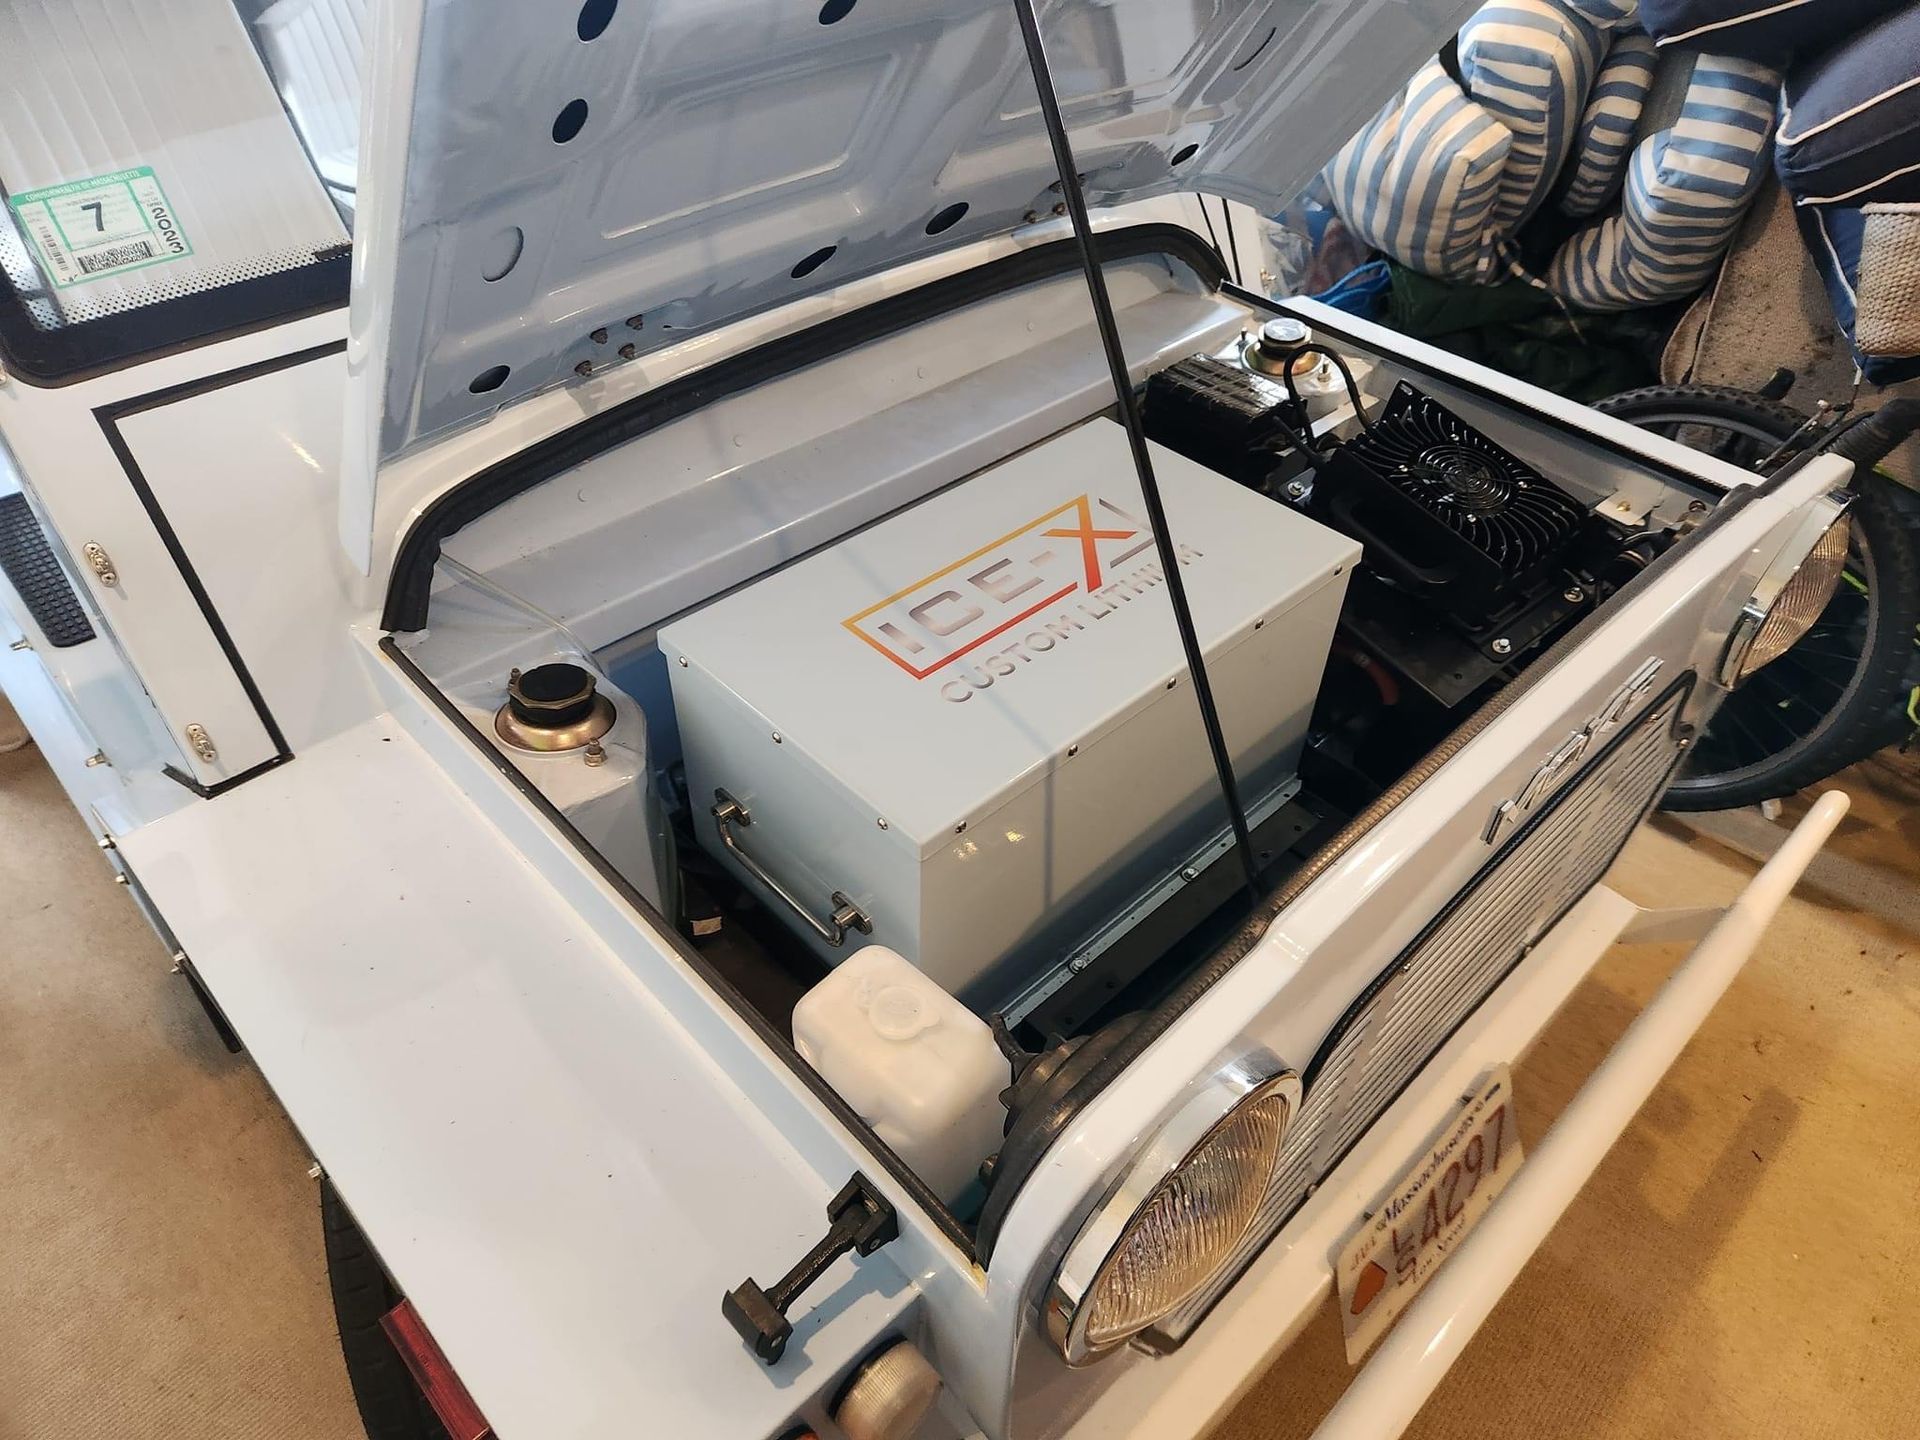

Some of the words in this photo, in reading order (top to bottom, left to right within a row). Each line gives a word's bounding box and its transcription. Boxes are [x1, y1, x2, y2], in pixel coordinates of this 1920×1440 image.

[81, 201, 104, 232] 7
[151, 207, 184, 254] 2023
[940, 614, 1085, 703] CUSTOM
[1077, 543, 1204, 620] LITHIM
